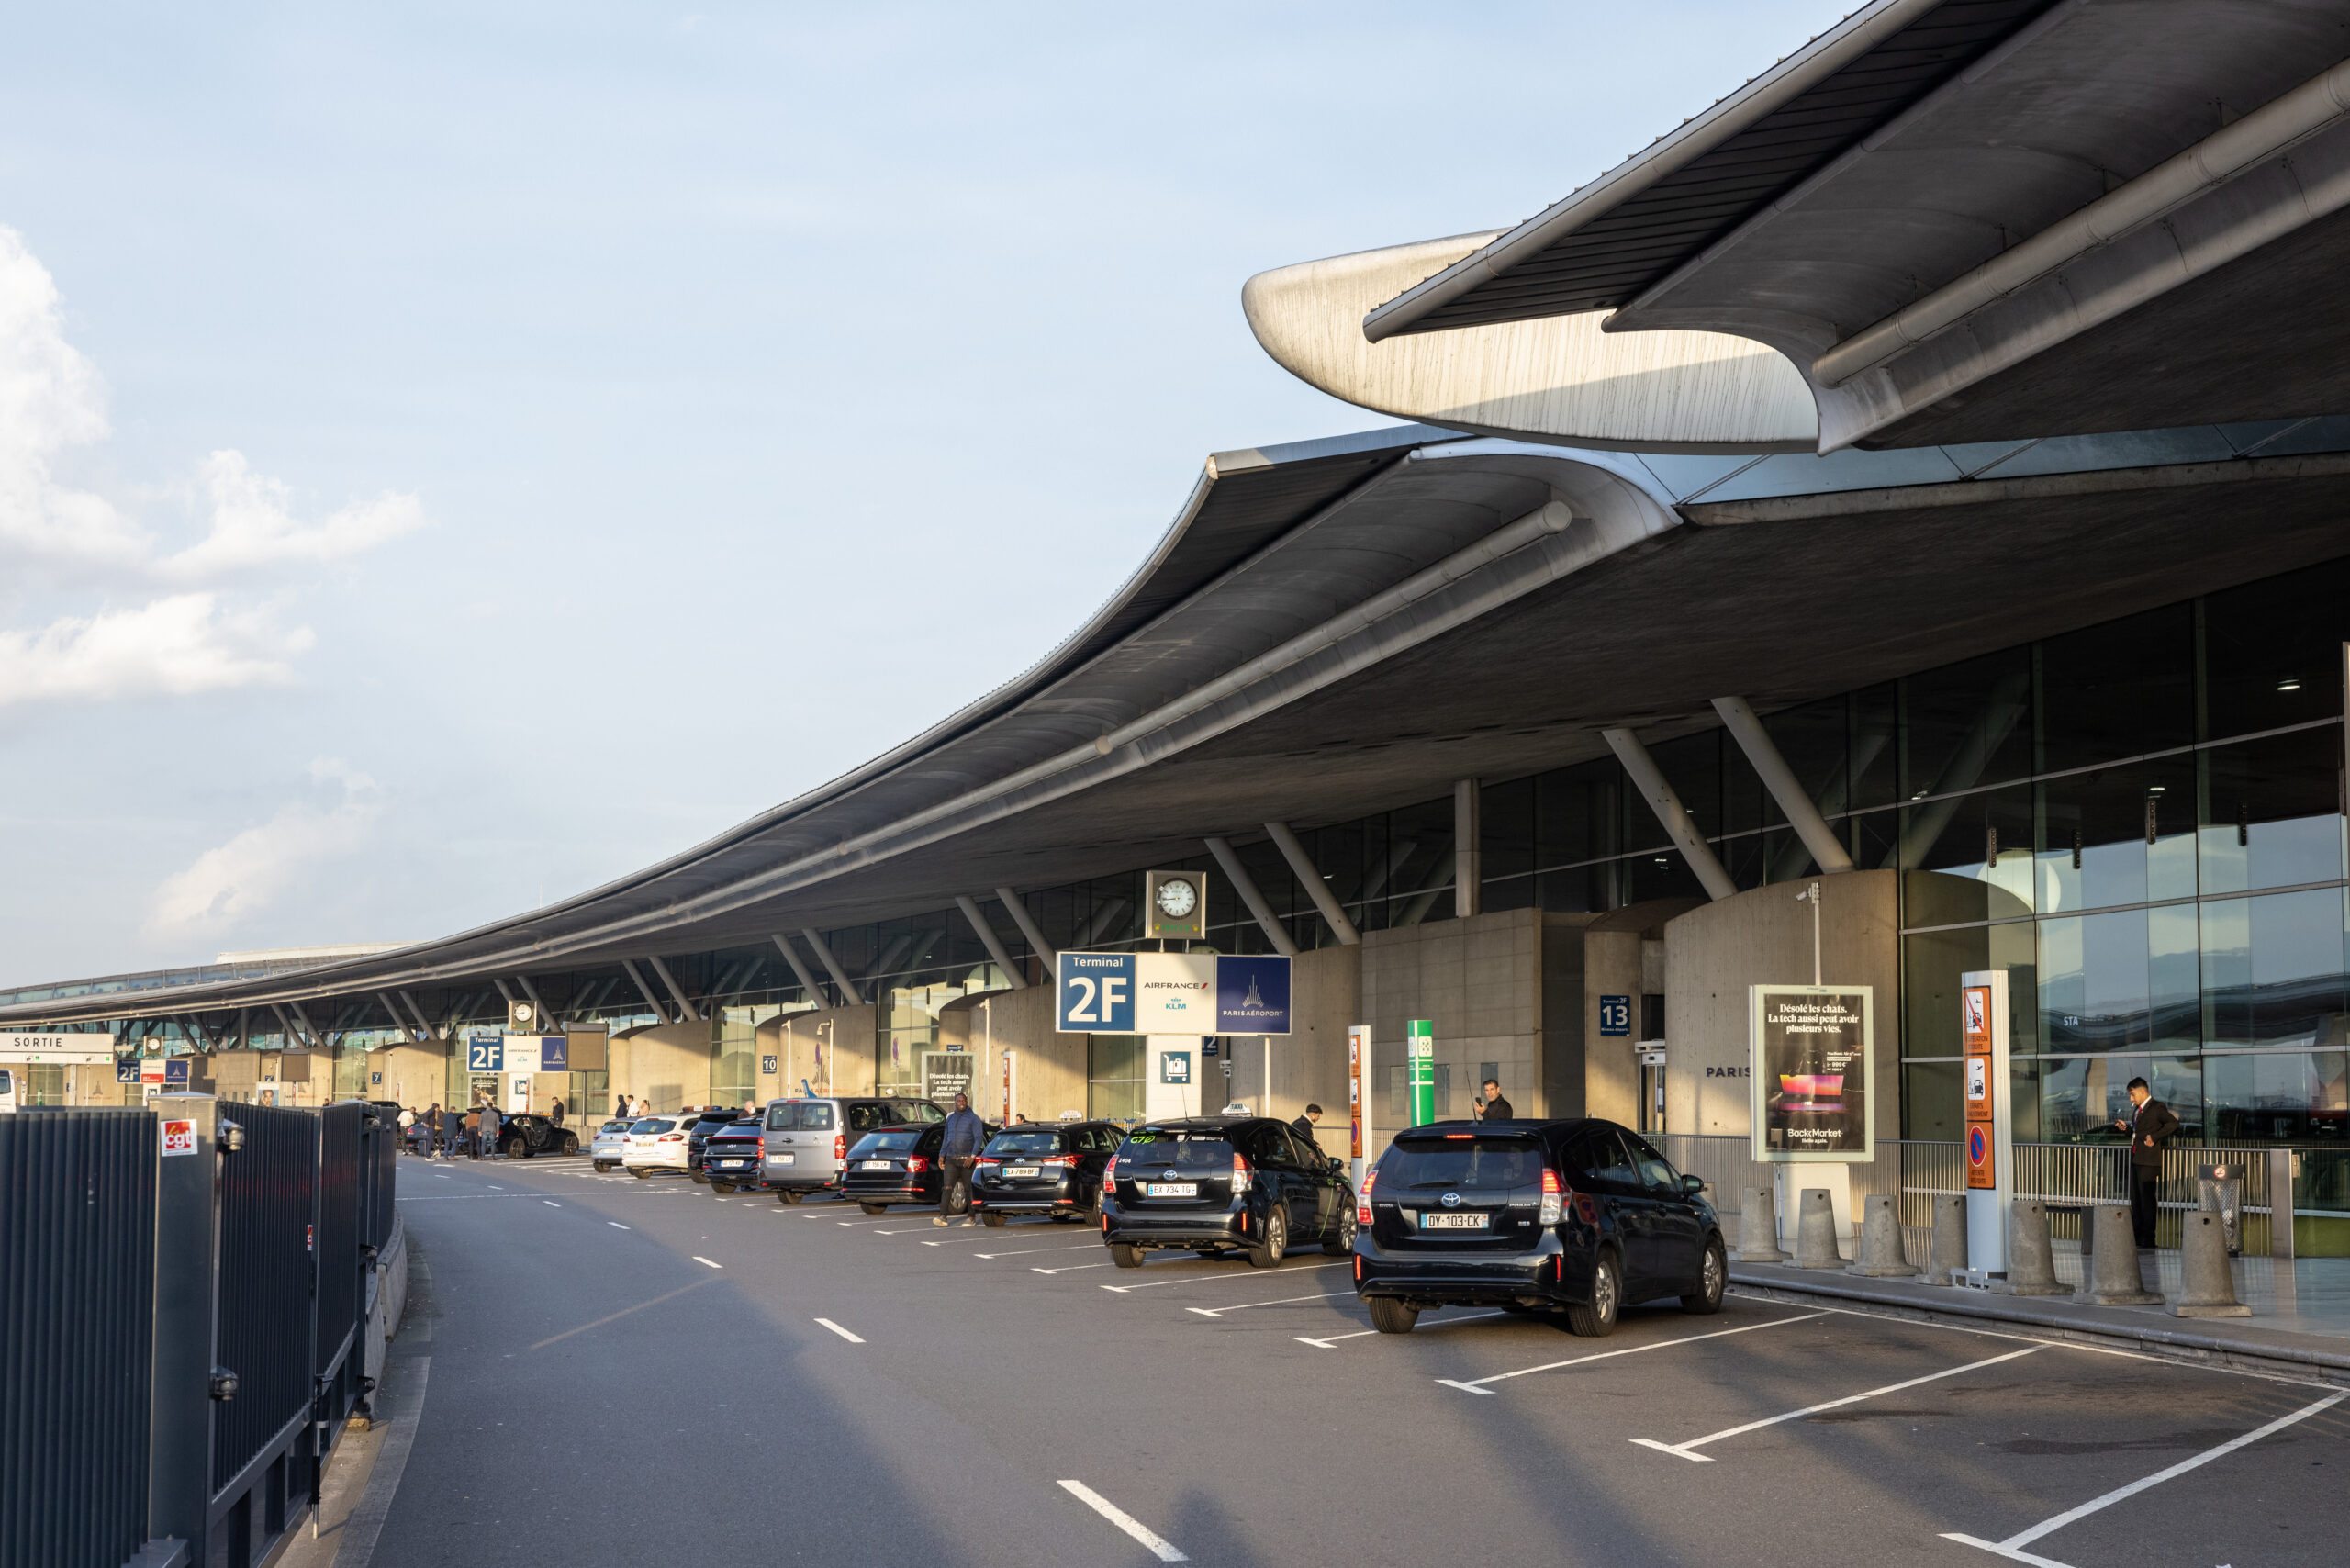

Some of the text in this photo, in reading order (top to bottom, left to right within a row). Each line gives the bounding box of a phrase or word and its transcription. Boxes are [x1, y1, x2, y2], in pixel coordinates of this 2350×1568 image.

[1072, 957, 1123, 967] Terminal
[1068, 977, 1127, 1022] 2F
[1780, 1003, 1847, 1014] Désolé les chats.
[1602, 1005, 1628, 1025] 13
[1768, 1014, 1778, 1023] La
[1780, 1014, 1796, 1023] tech
[1819, 1015, 1838, 1025] peut
[1839, 1015, 1859, 1024] avoir
[1786, 1025, 1841, 1034] plusieurs vies.
[14, 1037, 62, 1047] SORTIE
[472, 1047, 500, 1068] 2F
[764, 1060, 776, 1070] 10
[119, 1066, 139, 1081] 2F
[1707, 1067, 1750, 1077] PARIS
[166, 1130, 191, 1148] cgt
